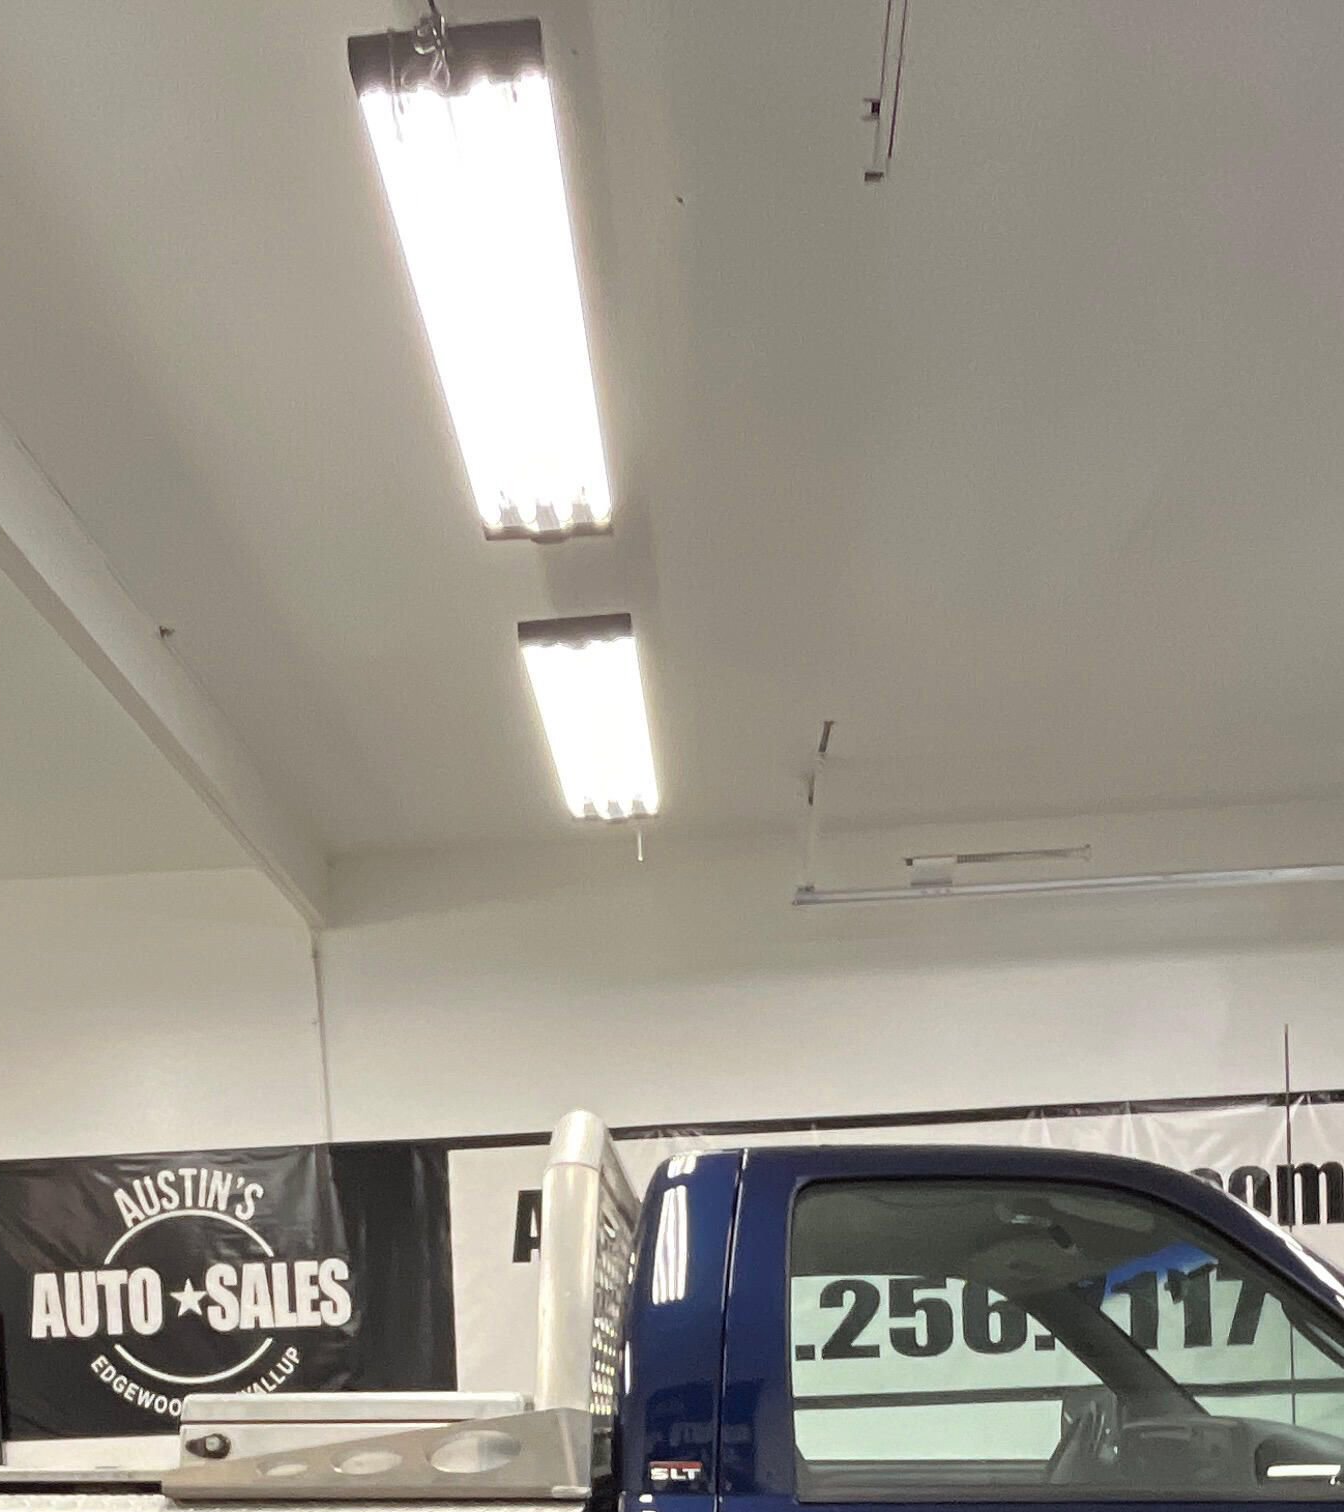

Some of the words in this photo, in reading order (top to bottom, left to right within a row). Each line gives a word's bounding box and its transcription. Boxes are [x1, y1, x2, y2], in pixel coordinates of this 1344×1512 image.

[113, 1168, 264, 1229] AUSTIN'S
[31, 1267, 163, 1340] AUTO
[205, 1258, 352, 1333] SALES
[90, 1354, 183, 1417] EDGEWOO
[650, 1467, 702, 1481] SLT
